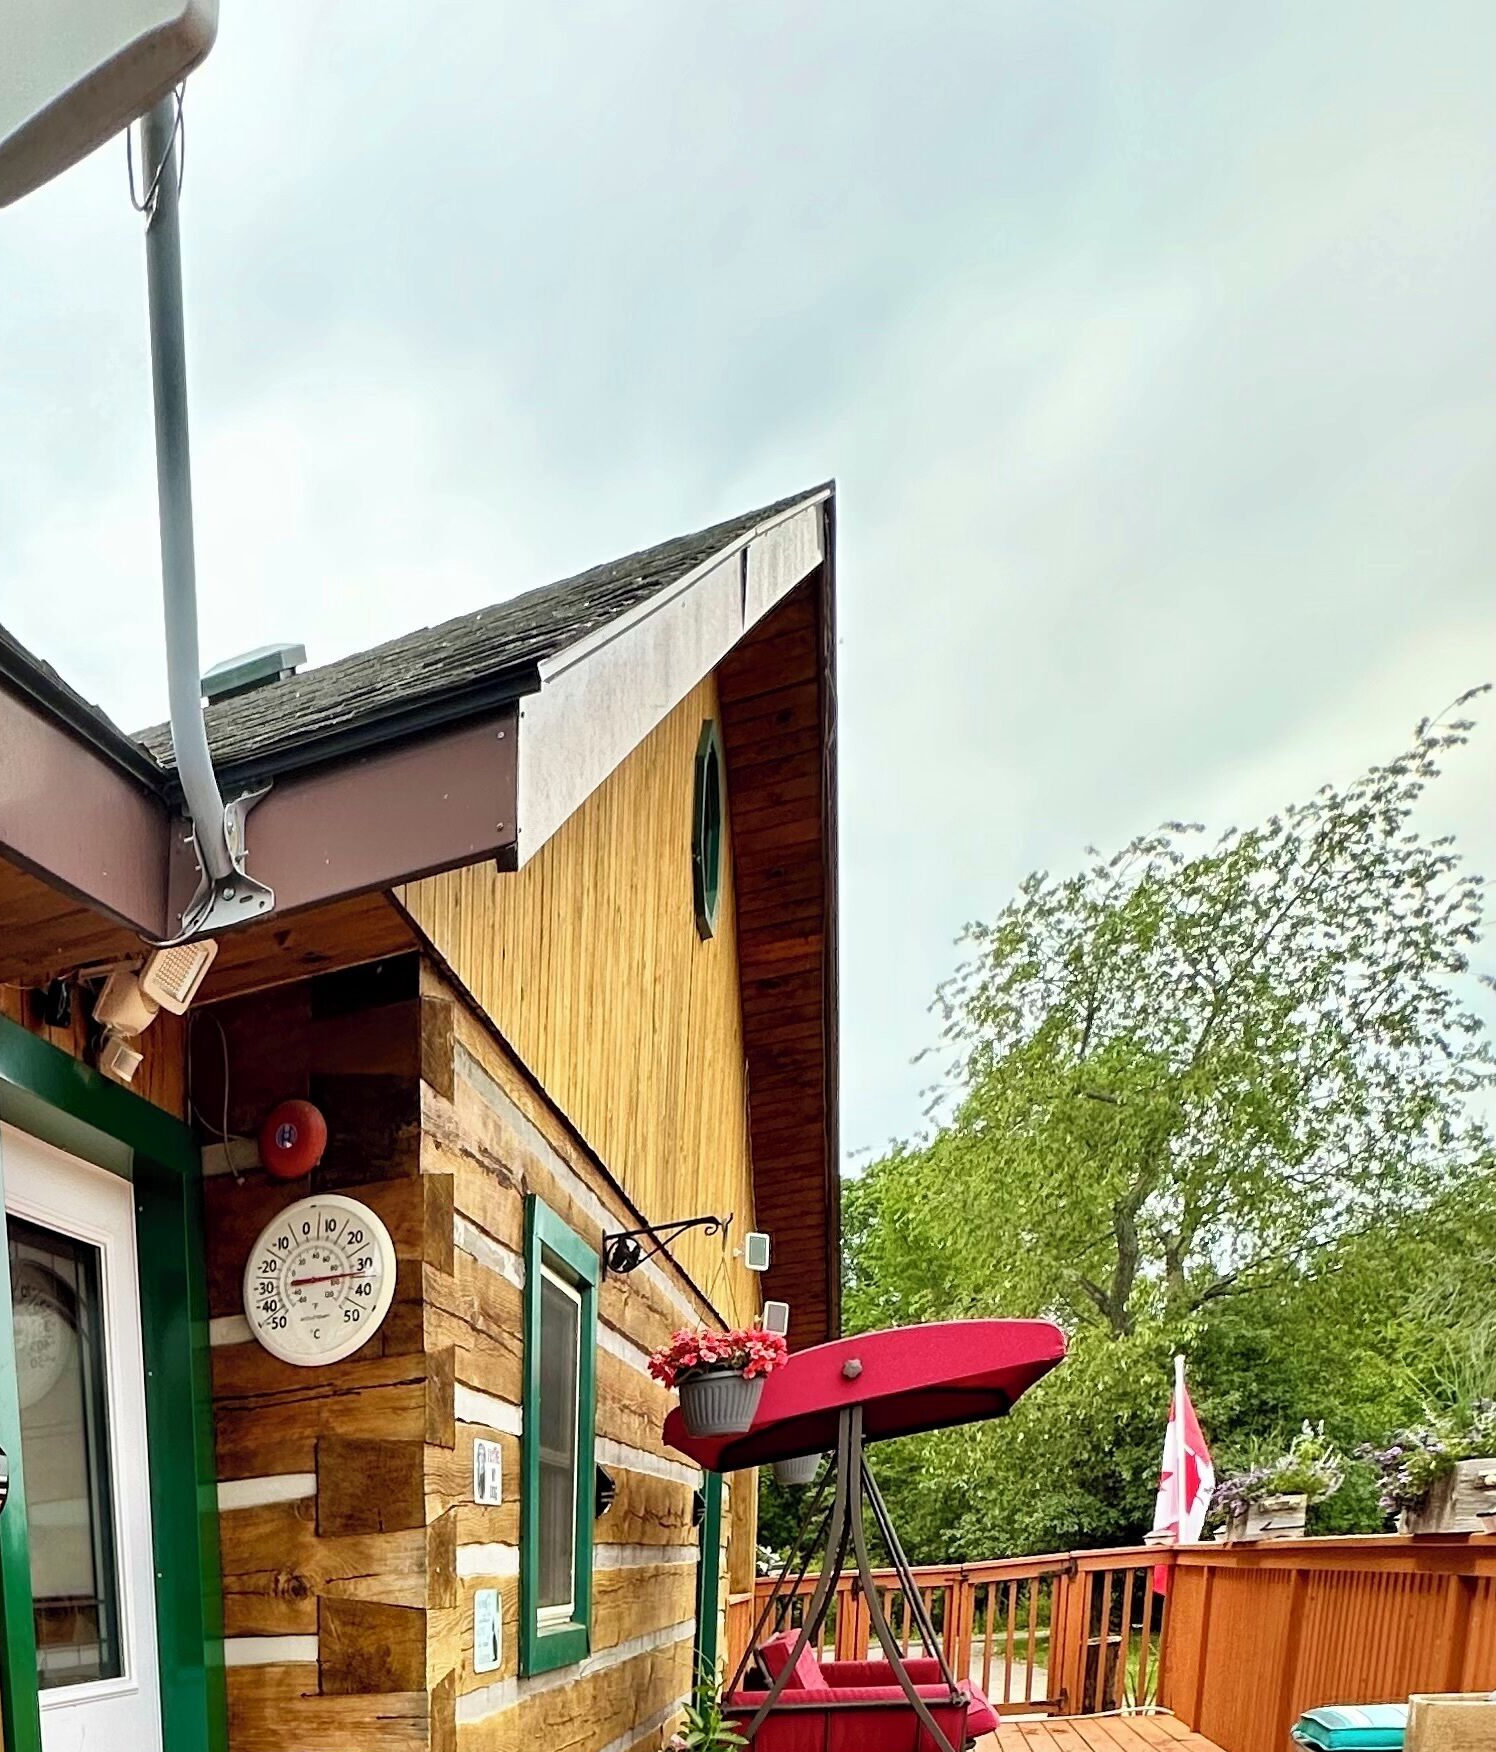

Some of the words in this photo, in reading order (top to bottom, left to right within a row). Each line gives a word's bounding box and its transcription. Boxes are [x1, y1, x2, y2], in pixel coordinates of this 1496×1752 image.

[302, 1221, 311, 1236] 0
[324, 1219, 337, 1232] 10
[272, 1236, 289, 1250] -10
[347, 1230, 364, 1245] 20
[257, 1259, 277, 1273] -20
[356, 1257, 373, 1272] 30
[253, 1281, 274, 1295] -30
[354, 1282, 372, 1296] 40
[256, 1299, 278, 1313] -40
[343, 1308, 360, 1323] 50
